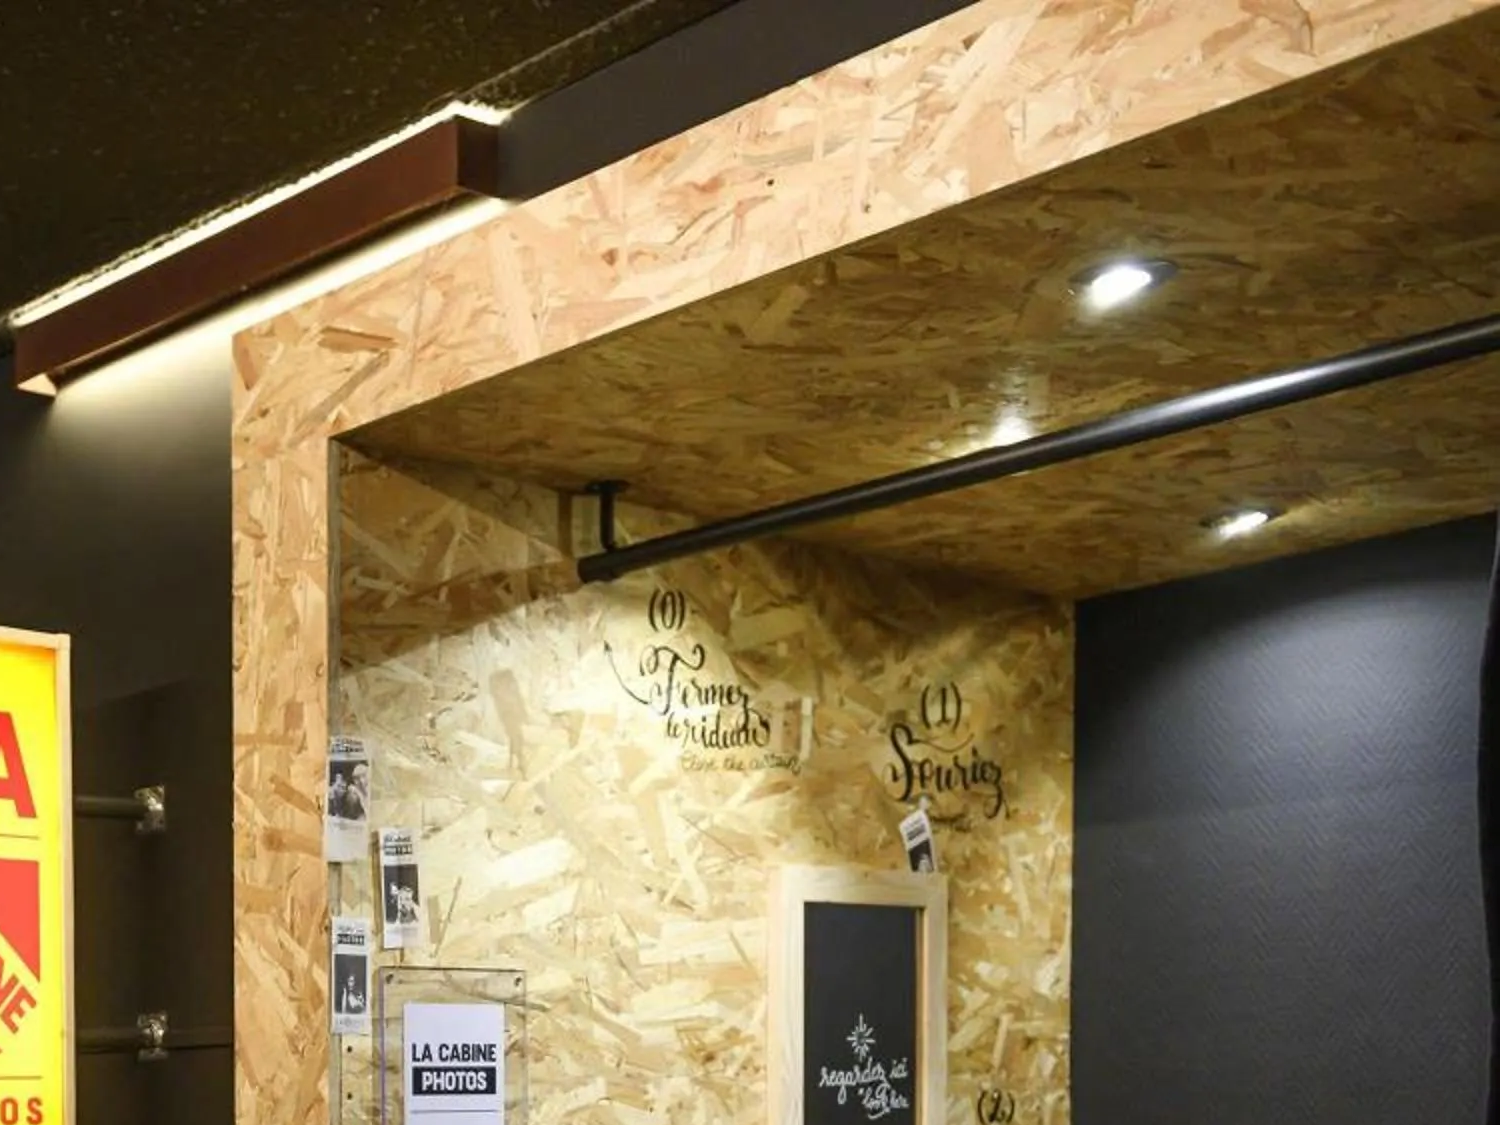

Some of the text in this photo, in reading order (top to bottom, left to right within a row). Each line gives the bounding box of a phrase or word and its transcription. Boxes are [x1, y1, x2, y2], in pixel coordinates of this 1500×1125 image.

[639, 643, 751, 717] Fermez
[921, 681, 961, 733] (1)
[882, 722, 1010, 820] Souriez
[411, 1043, 497, 1063] LA CABINE
[421, 1069, 488, 1092] PHOTOS
[819, 1056, 892, 1105] regardez
